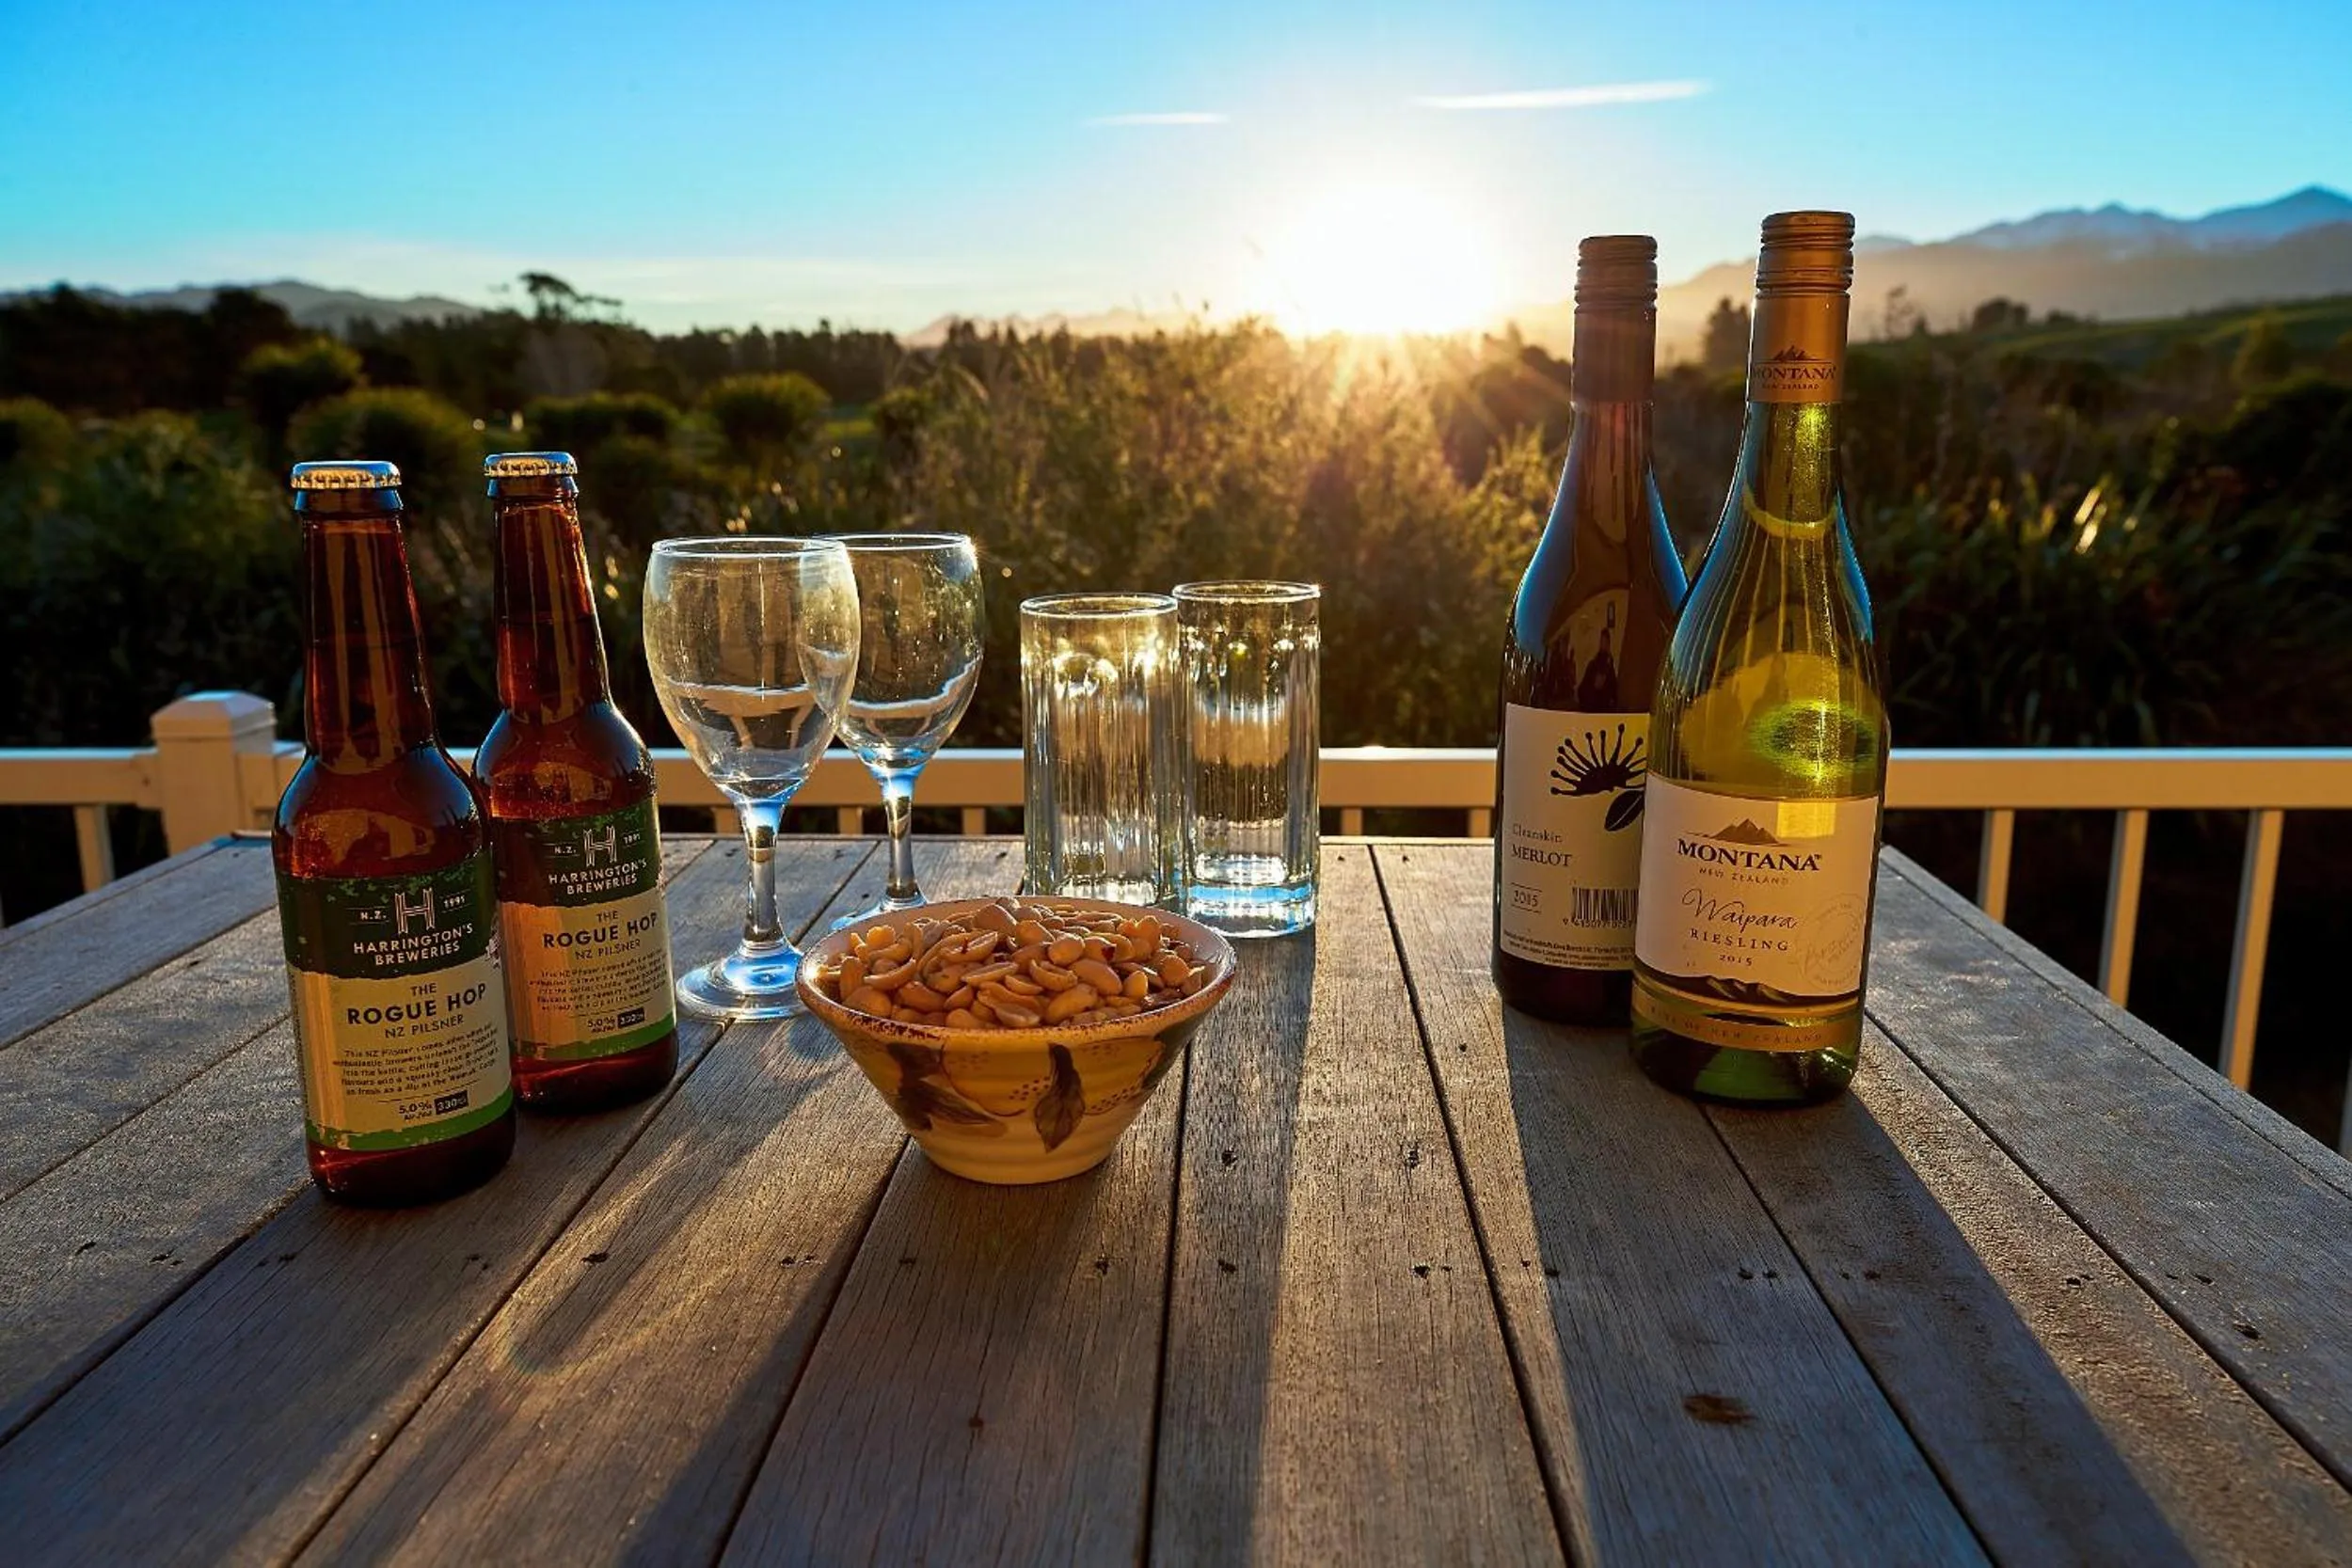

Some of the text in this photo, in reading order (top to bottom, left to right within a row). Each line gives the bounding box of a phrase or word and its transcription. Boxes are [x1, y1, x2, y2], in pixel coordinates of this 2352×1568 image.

[1512, 844, 1573, 867] MERLOT
[1677, 838, 1820, 871] MONTANA
[548, 858, 647, 884] HARRINGTON'S
[1699, 868, 1788, 885] NEW ZEALAND
[566, 873, 638, 895] BREWERIES
[360, 911, 387, 920] N.Z.
[596, 911, 619, 923] THE
[1681, 888, 1798, 934] Waipara
[353, 923, 473, 955] HARRINGTON'S
[542, 912, 658, 948] ROGUE HOP
[1690, 927, 1788, 952] RIESLING
[375, 941, 461, 966] BREWERIES
[575, 939, 641, 960] NZ PILSNER
[1719, 954, 1753, 967] 2015
[410, 983, 437, 996] THE
[346, 983, 486, 1025] ROGUE HOP
[385, 1026, 405, 1039] NZ
[411, 1014, 465, 1036] PILSNER
[399, 1101, 434, 1115] 5.0%
